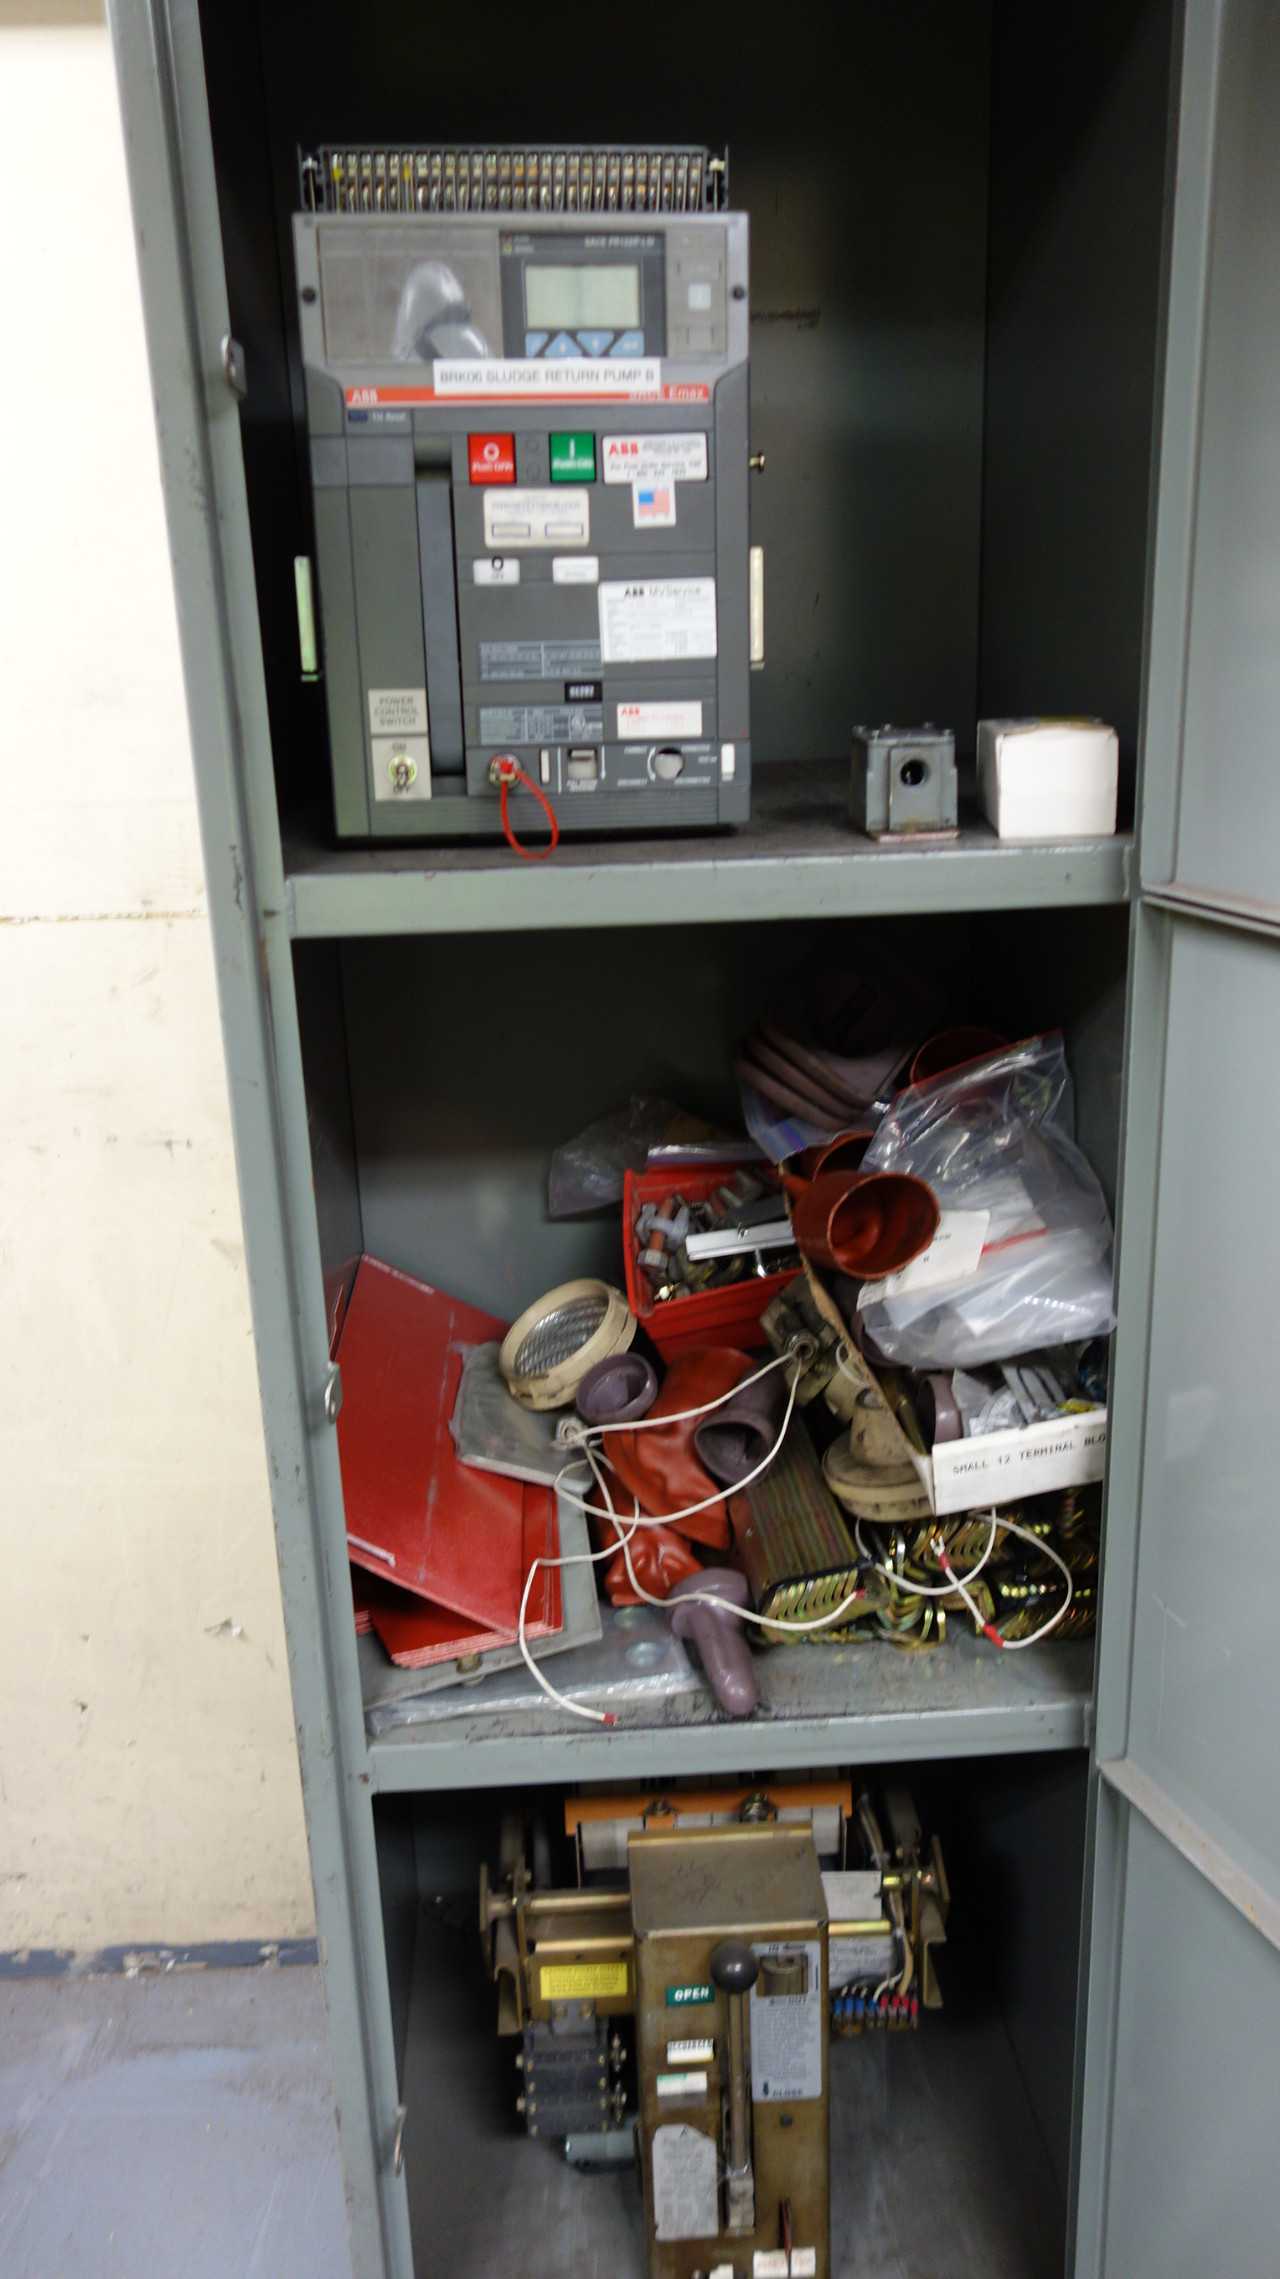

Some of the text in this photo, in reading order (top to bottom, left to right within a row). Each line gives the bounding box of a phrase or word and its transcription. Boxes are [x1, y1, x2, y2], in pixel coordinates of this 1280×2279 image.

[487, 367, 539, 383] SLUDGE
[544, 367, 599, 383] RETURN
[603, 367, 641, 382] PUMP
[351, 387, 378, 403] ABB
[608, 441, 639, 456] ABB
[624, 586, 645, 598] ABB
[379, 696, 414, 705] POWER
[374, 706, 418, 716] CONTROL
[379, 717, 416, 727] SWITCH
[952, 1458, 986, 1475] SMALL
[999, 1454, 1011, 1465] 12
[1019, 1441, 1074, 1461] TERMINAL
[673, 1986, 710, 2002] OPEN
